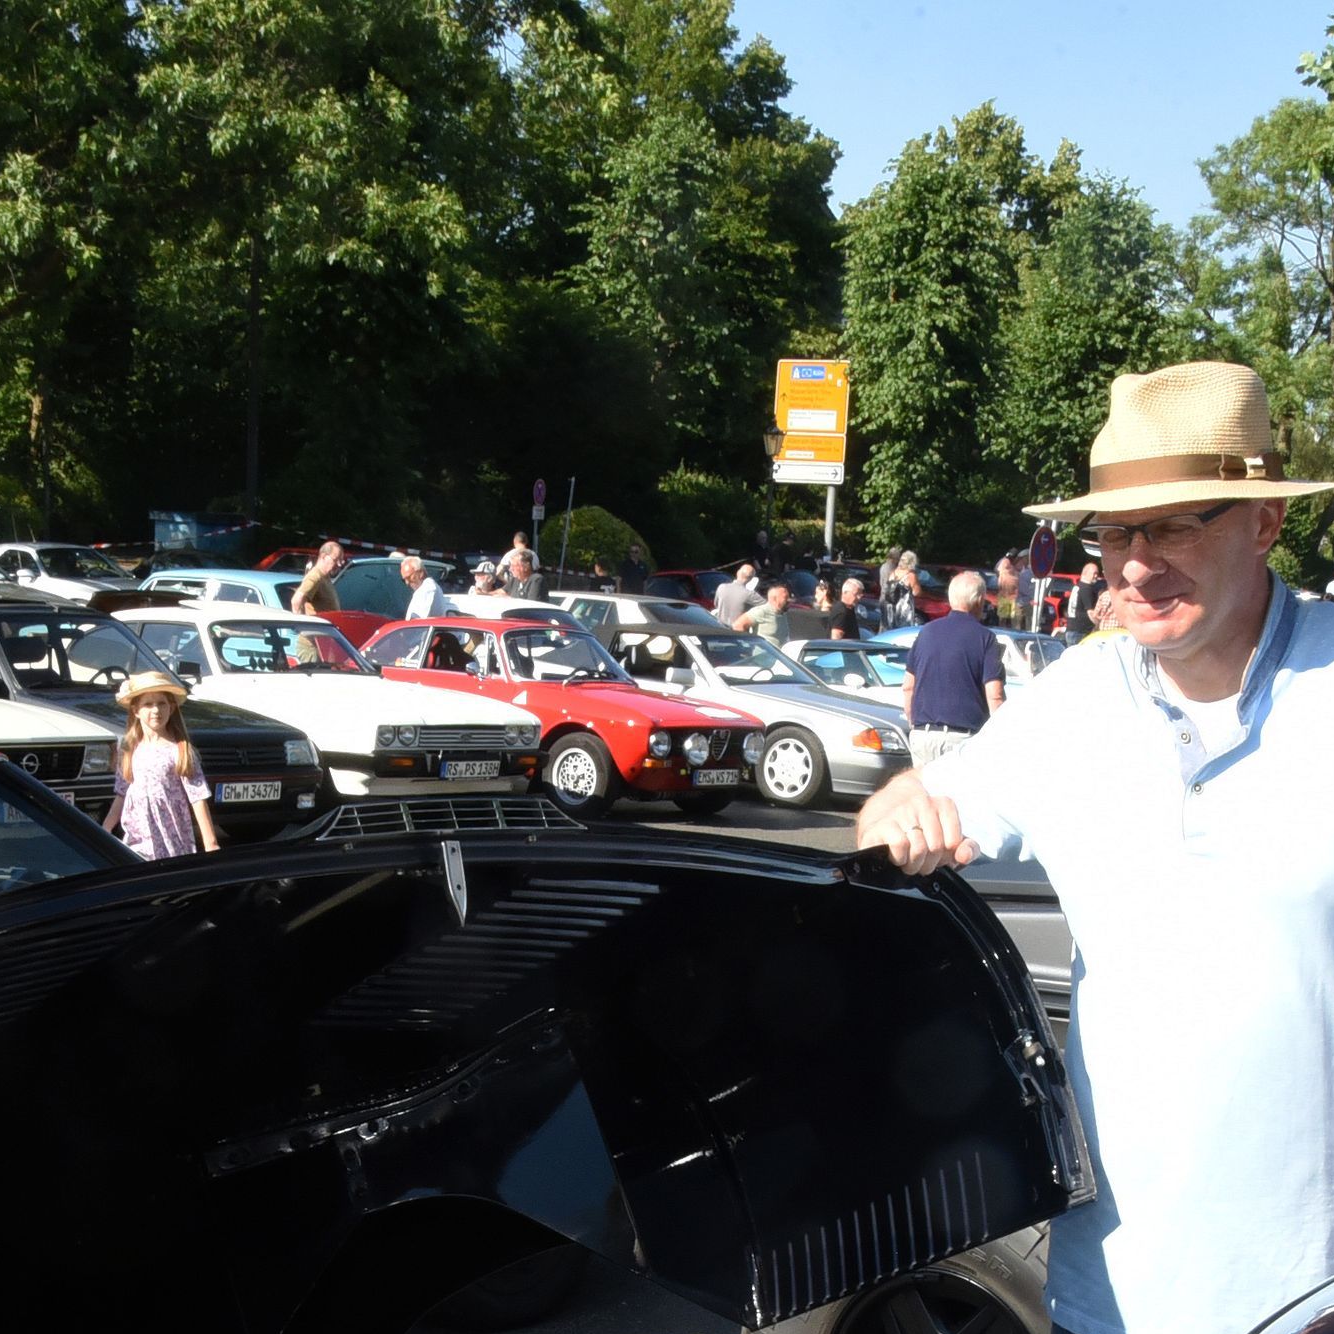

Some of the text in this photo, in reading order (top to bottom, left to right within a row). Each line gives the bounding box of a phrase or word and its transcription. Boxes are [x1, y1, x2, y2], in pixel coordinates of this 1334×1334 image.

[447, 764, 458, 776] RS
[224, 785, 236, 799] GM
[250, 783, 279, 799] 3437H
